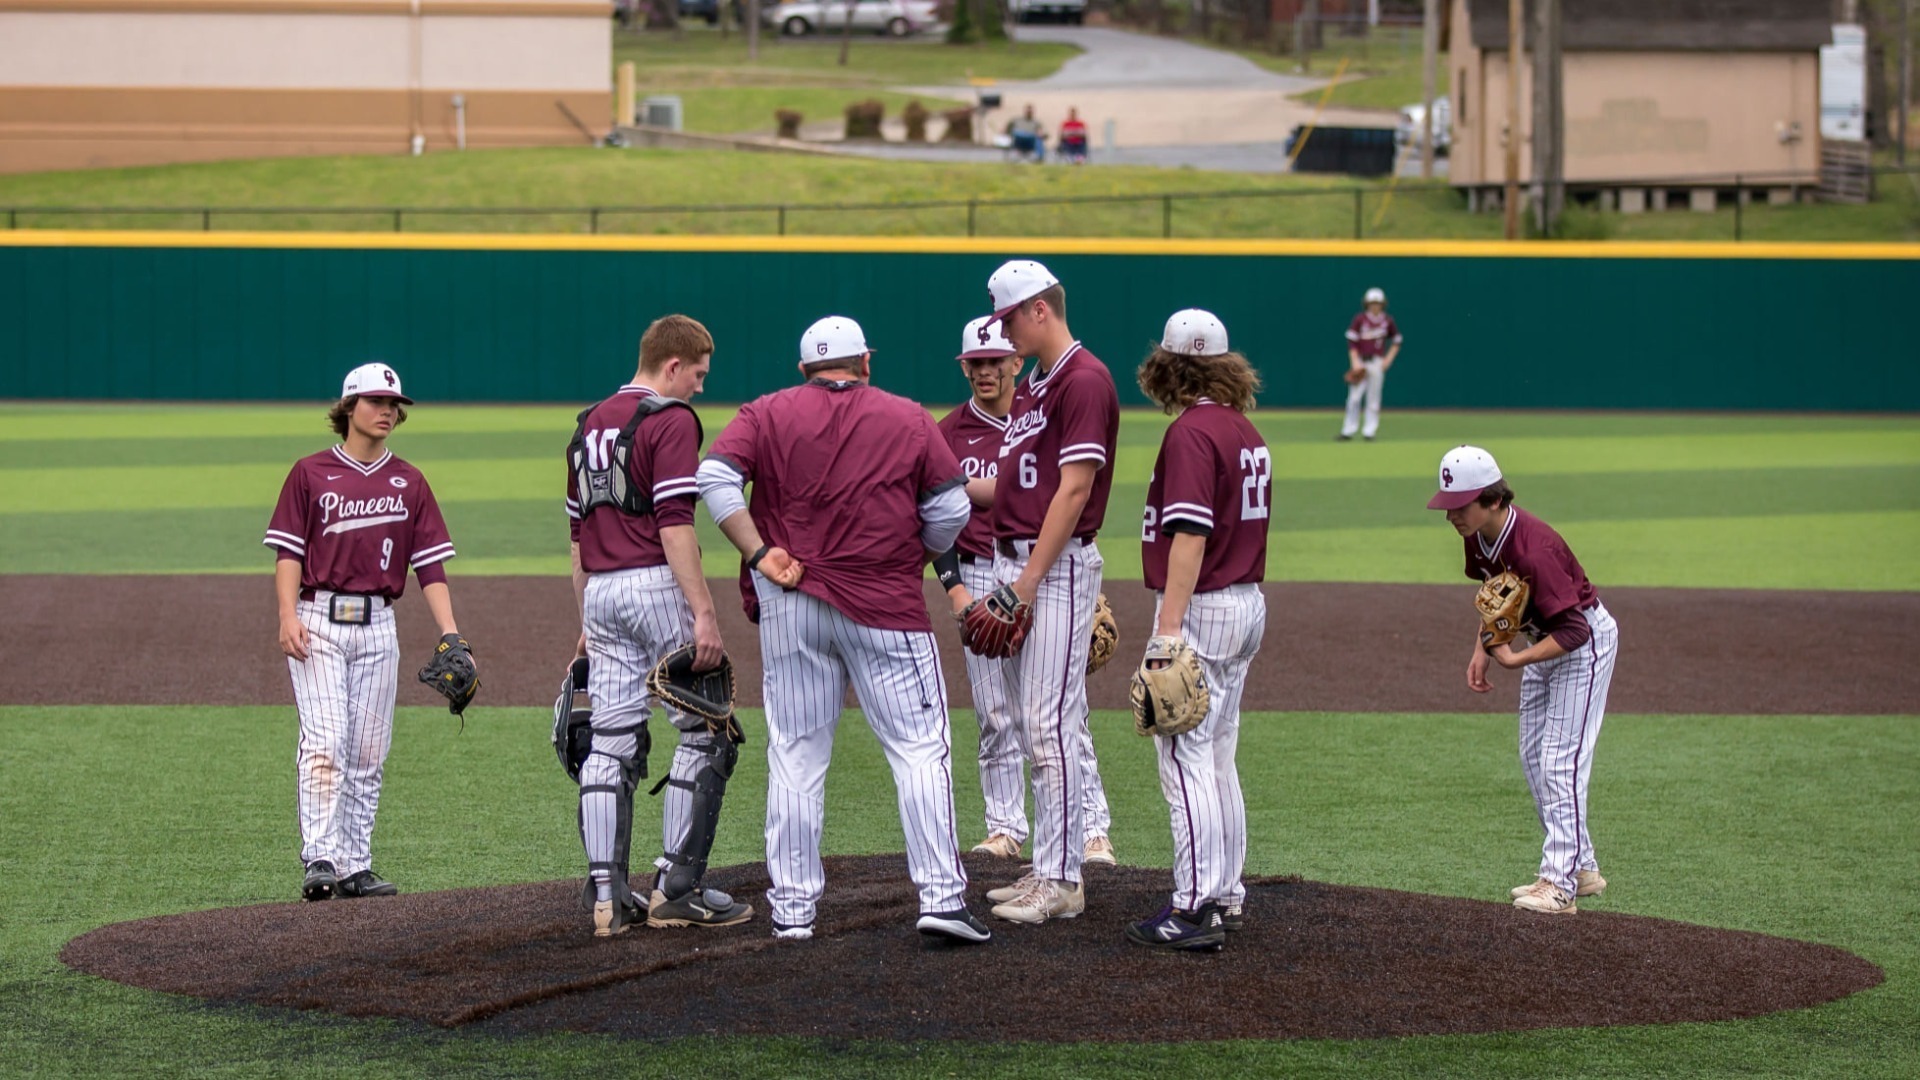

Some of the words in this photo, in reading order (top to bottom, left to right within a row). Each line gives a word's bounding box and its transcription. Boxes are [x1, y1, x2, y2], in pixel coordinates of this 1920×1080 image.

[1019, 452, 1037, 488] 6
[1240, 446, 1271, 520] 22
[319, 492, 408, 524] Pioneers
[381, 537, 393, 571] 9
